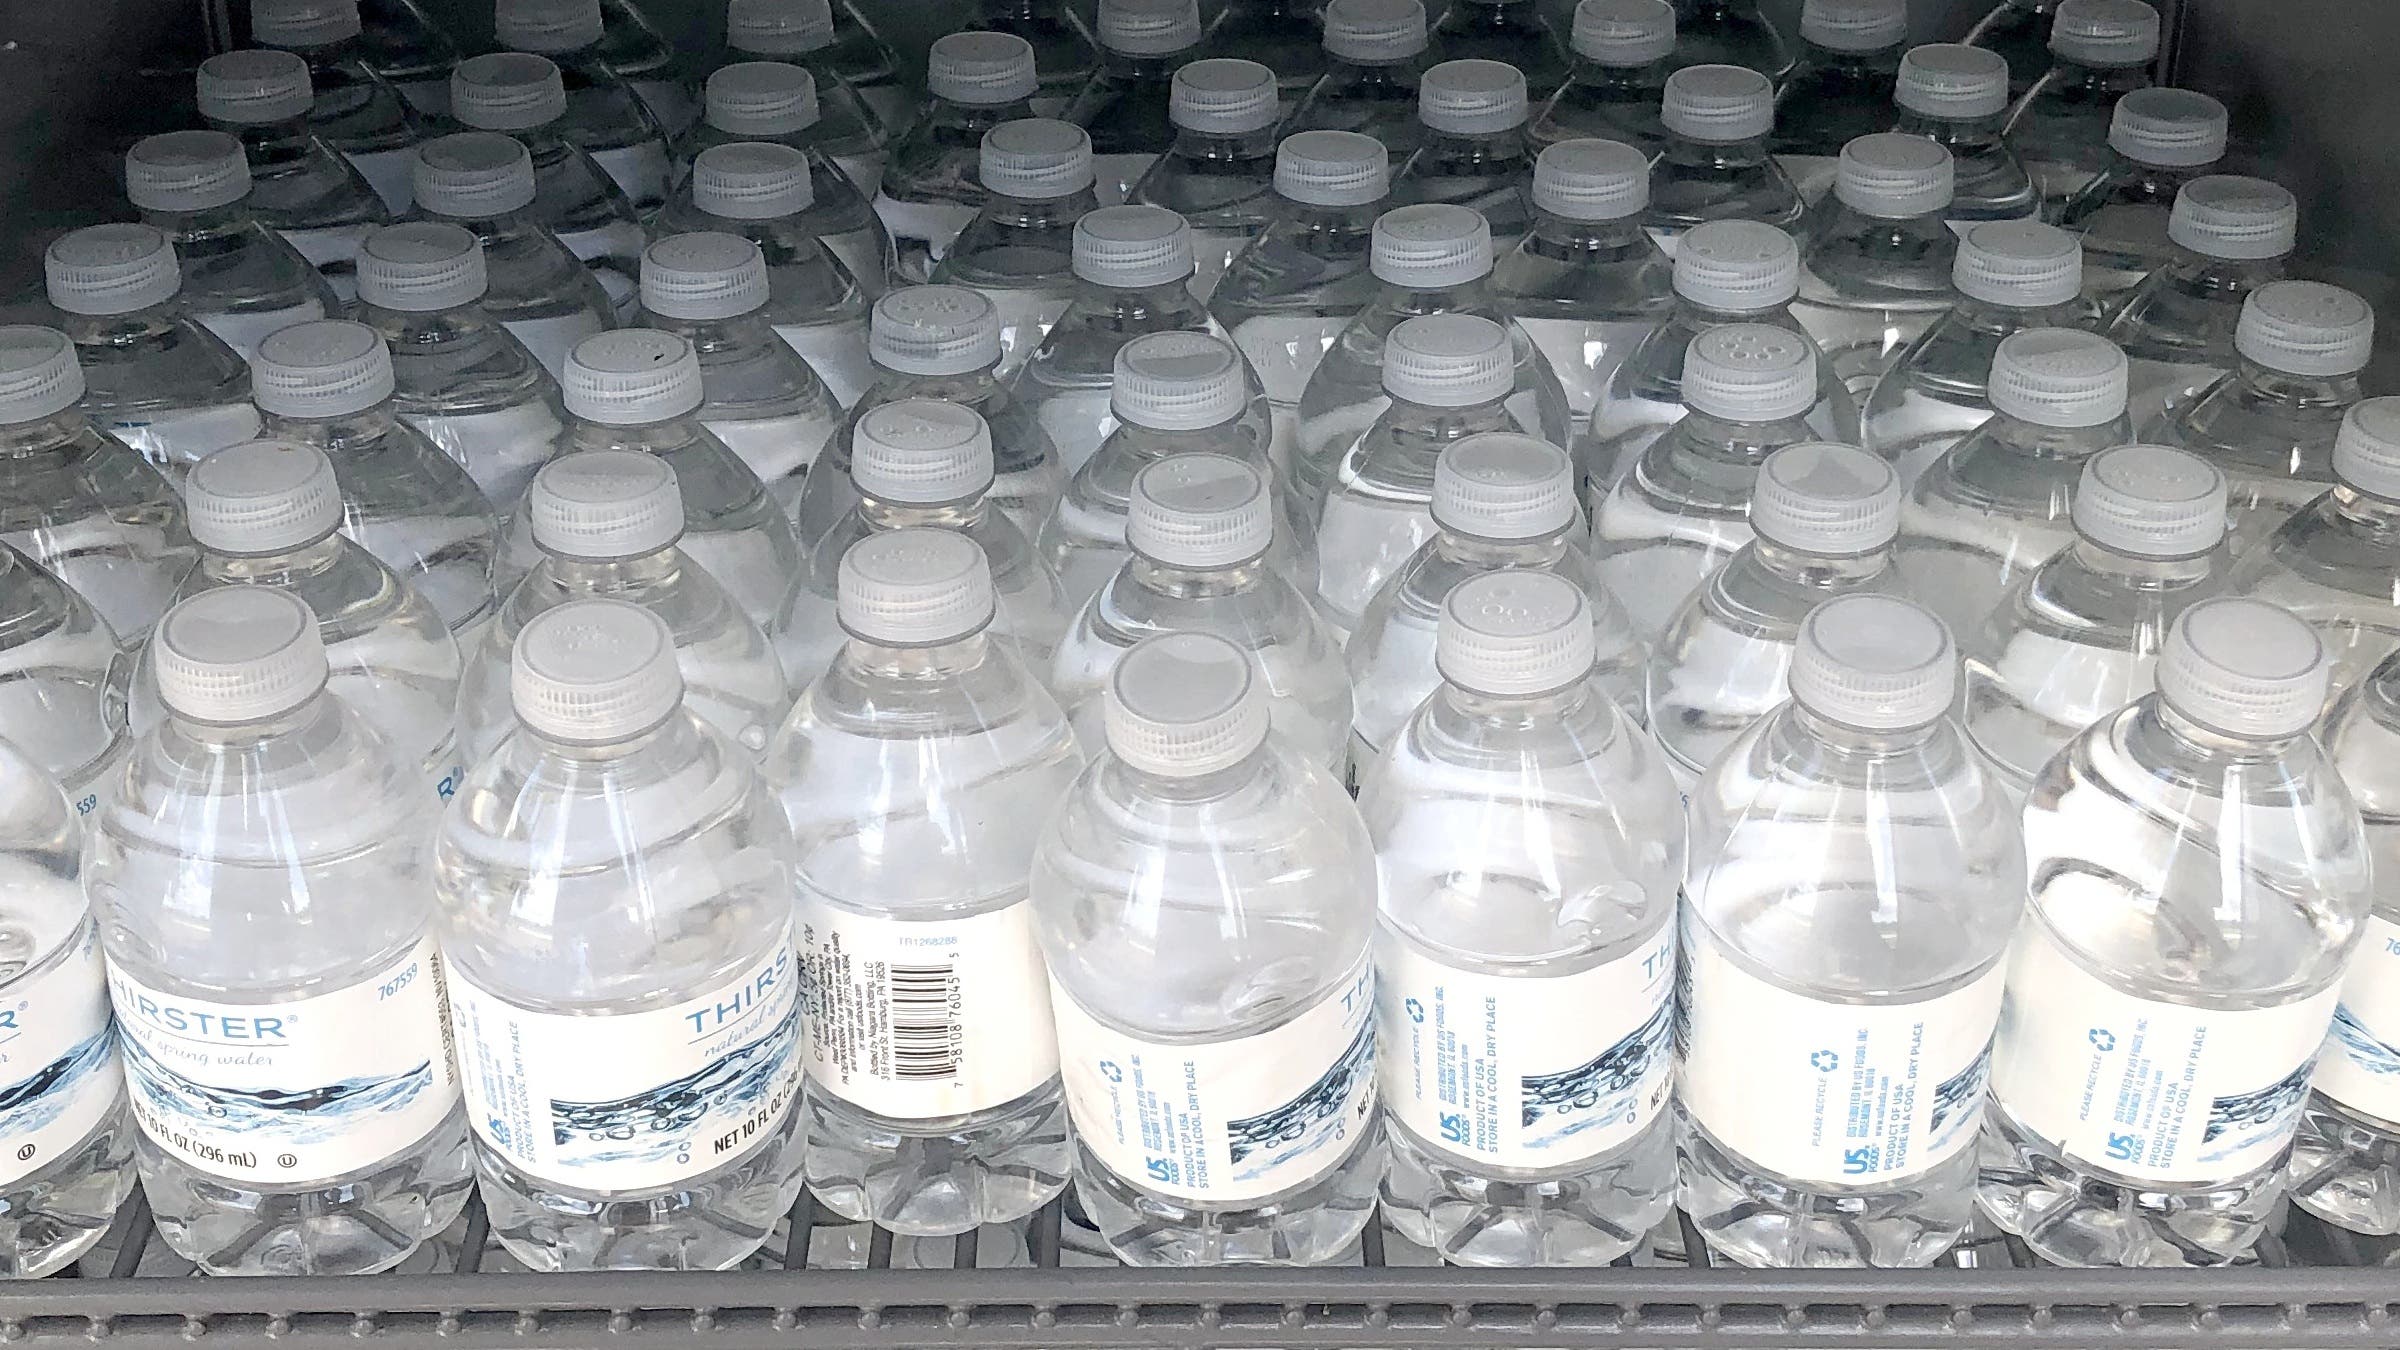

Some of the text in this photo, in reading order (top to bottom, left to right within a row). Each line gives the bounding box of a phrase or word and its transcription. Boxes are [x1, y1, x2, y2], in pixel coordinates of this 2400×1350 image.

[377, 961, 418, 1001] 767559
[864, 961, 874, 978] LLC
[685, 947, 787, 1033] THIRS
[948, 977, 961, 1018] 76045
[1486, 996, 1496, 1032] PLACE
[949, 1024, 963, 1064] 58108
[1487, 1034, 1496, 1057] DRY
[1911, 1022, 1924, 1056] PLACE
[2190, 1026, 2206, 1059] PLACE
[1184, 1060, 1197, 1091] PLACE
[1908, 1058, 1918, 1080] DRY
[2185, 1061, 2197, 1082] DRY
[1188, 1092, 1200, 1111] DRY
[1475, 1058, 1486, 1151] PRODUCT OF USA
[1488, 1105, 1497, 1116] IN
[1903, 1113, 1912, 1121] A
[714, 1129, 739, 1155] NET
[742, 1119, 755, 1139] 10
[757, 1108, 769, 1128] FL
[771, 1091, 782, 1114] OZ
[1179, 1113, 1190, 1130] USA
[1489, 1118, 1498, 1153] STORE
[1884, 1083, 1904, 1171] PRODUCT OF USA
[1901, 1123, 1910, 1134] IN
[2148, 1082, 2178, 1167] PRODUCT OF USA
[2170, 1125, 2181, 1135] IN
[159, 1123, 173, 1143] FL
[174, 1132, 191, 1153] OZ
[192, 1140, 224, 1164] (296
[228, 1151, 257, 1169] mL)
[1196, 1148, 1205, 1158] IN
[1896, 1135, 1908, 1168] STORE
[2161, 1137, 2178, 1169] STORE
[1183, 1144, 1196, 1188] PRODUCT
[1197, 1159, 1210, 1189] STORE
